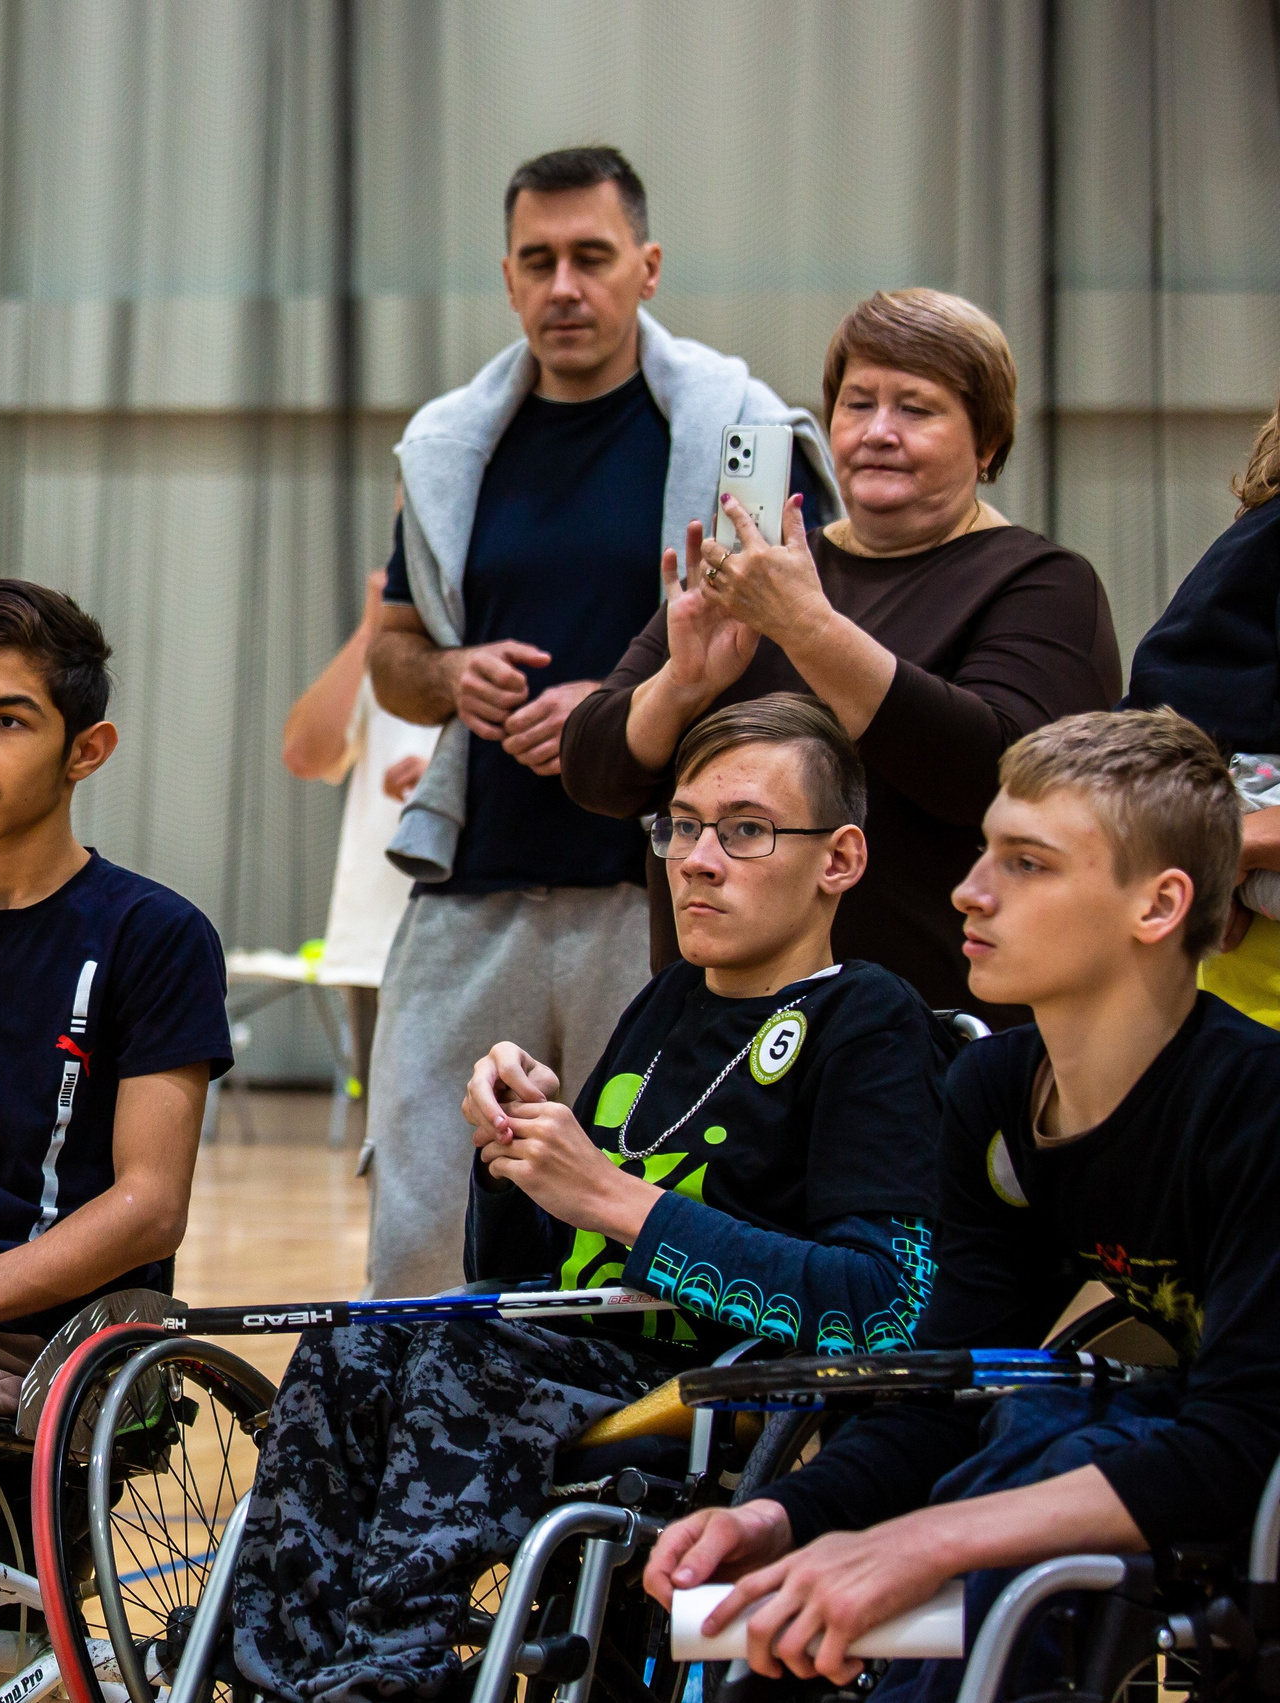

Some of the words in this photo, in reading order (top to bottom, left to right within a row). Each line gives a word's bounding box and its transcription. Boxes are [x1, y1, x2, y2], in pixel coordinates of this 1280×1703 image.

[769, 1029, 795, 1060] 5
[60, 1072, 77, 1108] PUMA
[243, 1309, 333, 1327] HEAD
[21, 1668, 44, 1694] Pro
